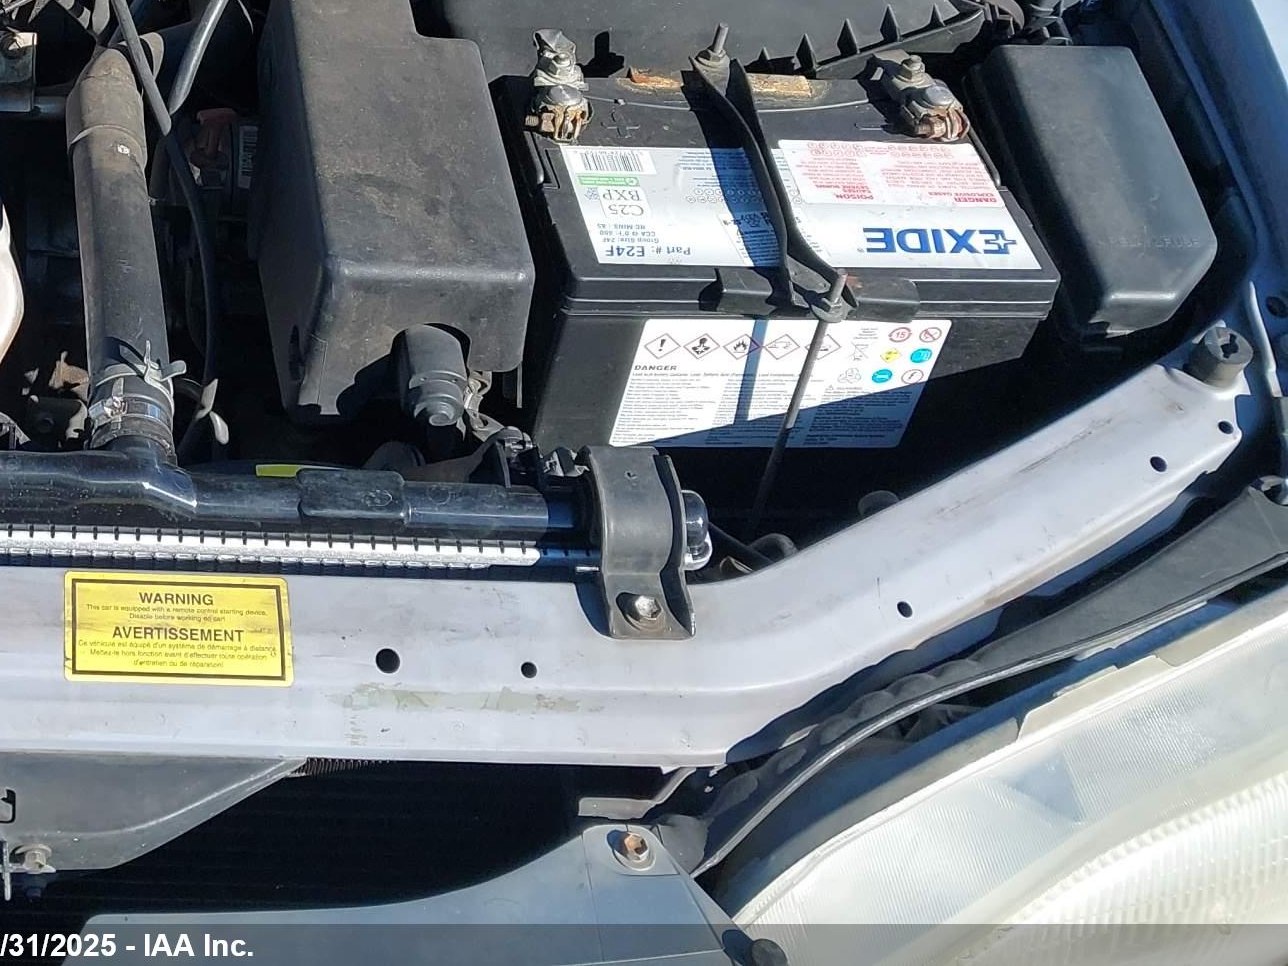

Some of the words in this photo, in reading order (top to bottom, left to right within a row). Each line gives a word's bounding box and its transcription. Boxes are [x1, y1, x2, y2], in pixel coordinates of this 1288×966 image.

[602, 189, 643, 201] BXP
[608, 203, 644, 216] C25
[863, 227, 1017, 255] EXIDE
[605, 245, 645, 257] E24F
[666, 246, 691, 255] Part
[139, 592, 214, 605] WARNING
[120, 605, 150, 613] equipped
[112, 626, 244, 642] AVERTISSEMENT
[129, 641, 151, 649] équipé
[207, 644, 242, 652] démarrage
